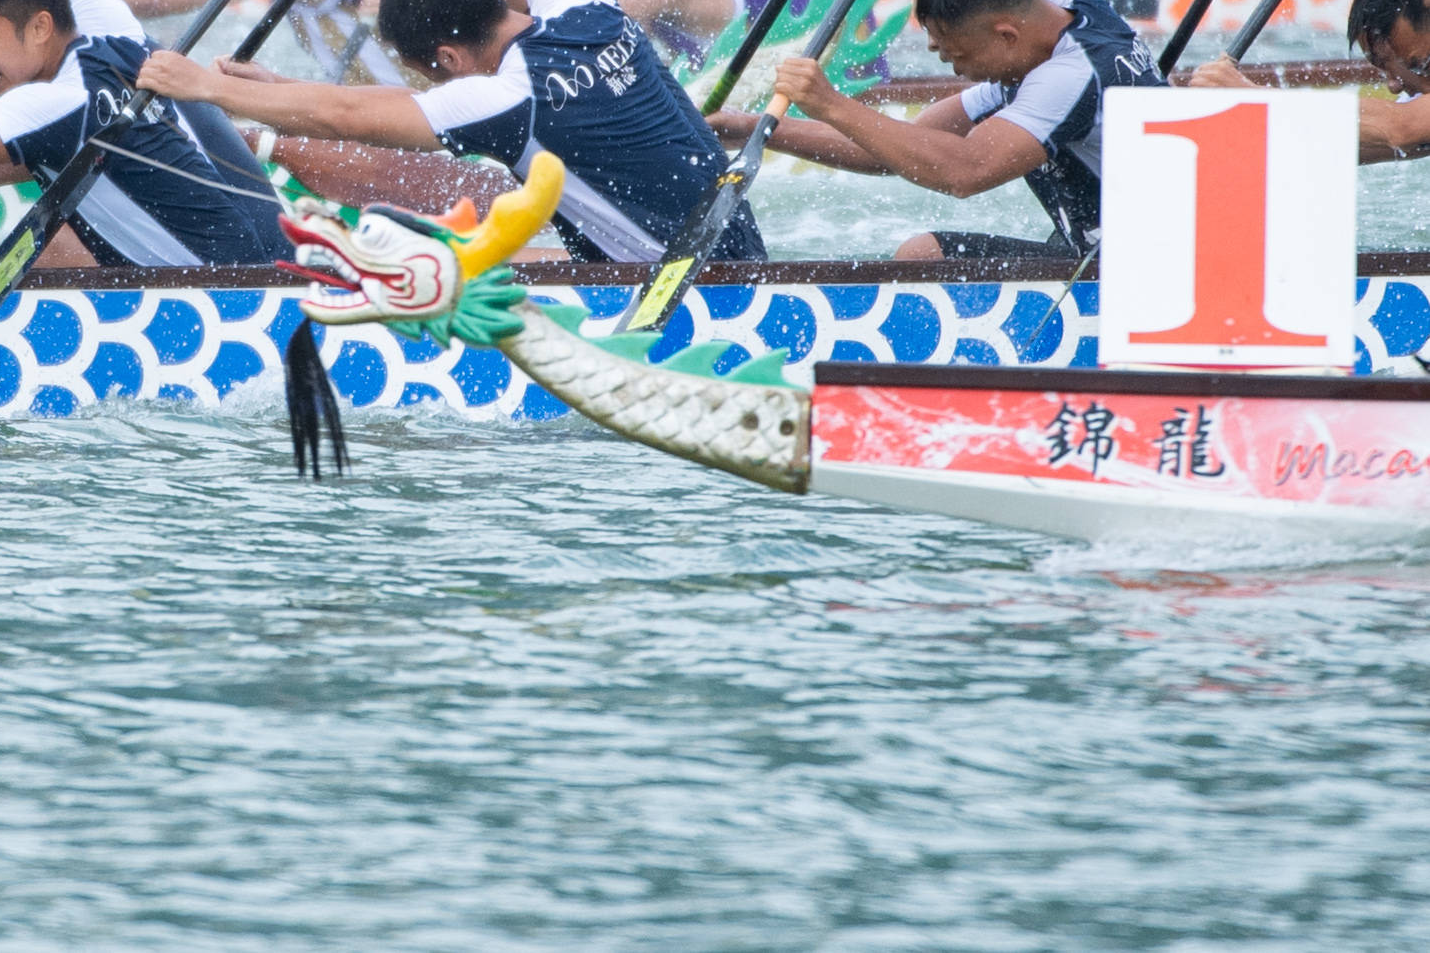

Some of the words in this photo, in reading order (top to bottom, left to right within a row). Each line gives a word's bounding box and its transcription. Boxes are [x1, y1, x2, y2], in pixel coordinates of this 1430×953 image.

[1128, 103, 1327, 347] 1
[1043, 401, 1226, 478] 錦龍
[1274, 441, 1430, 487] Maca
